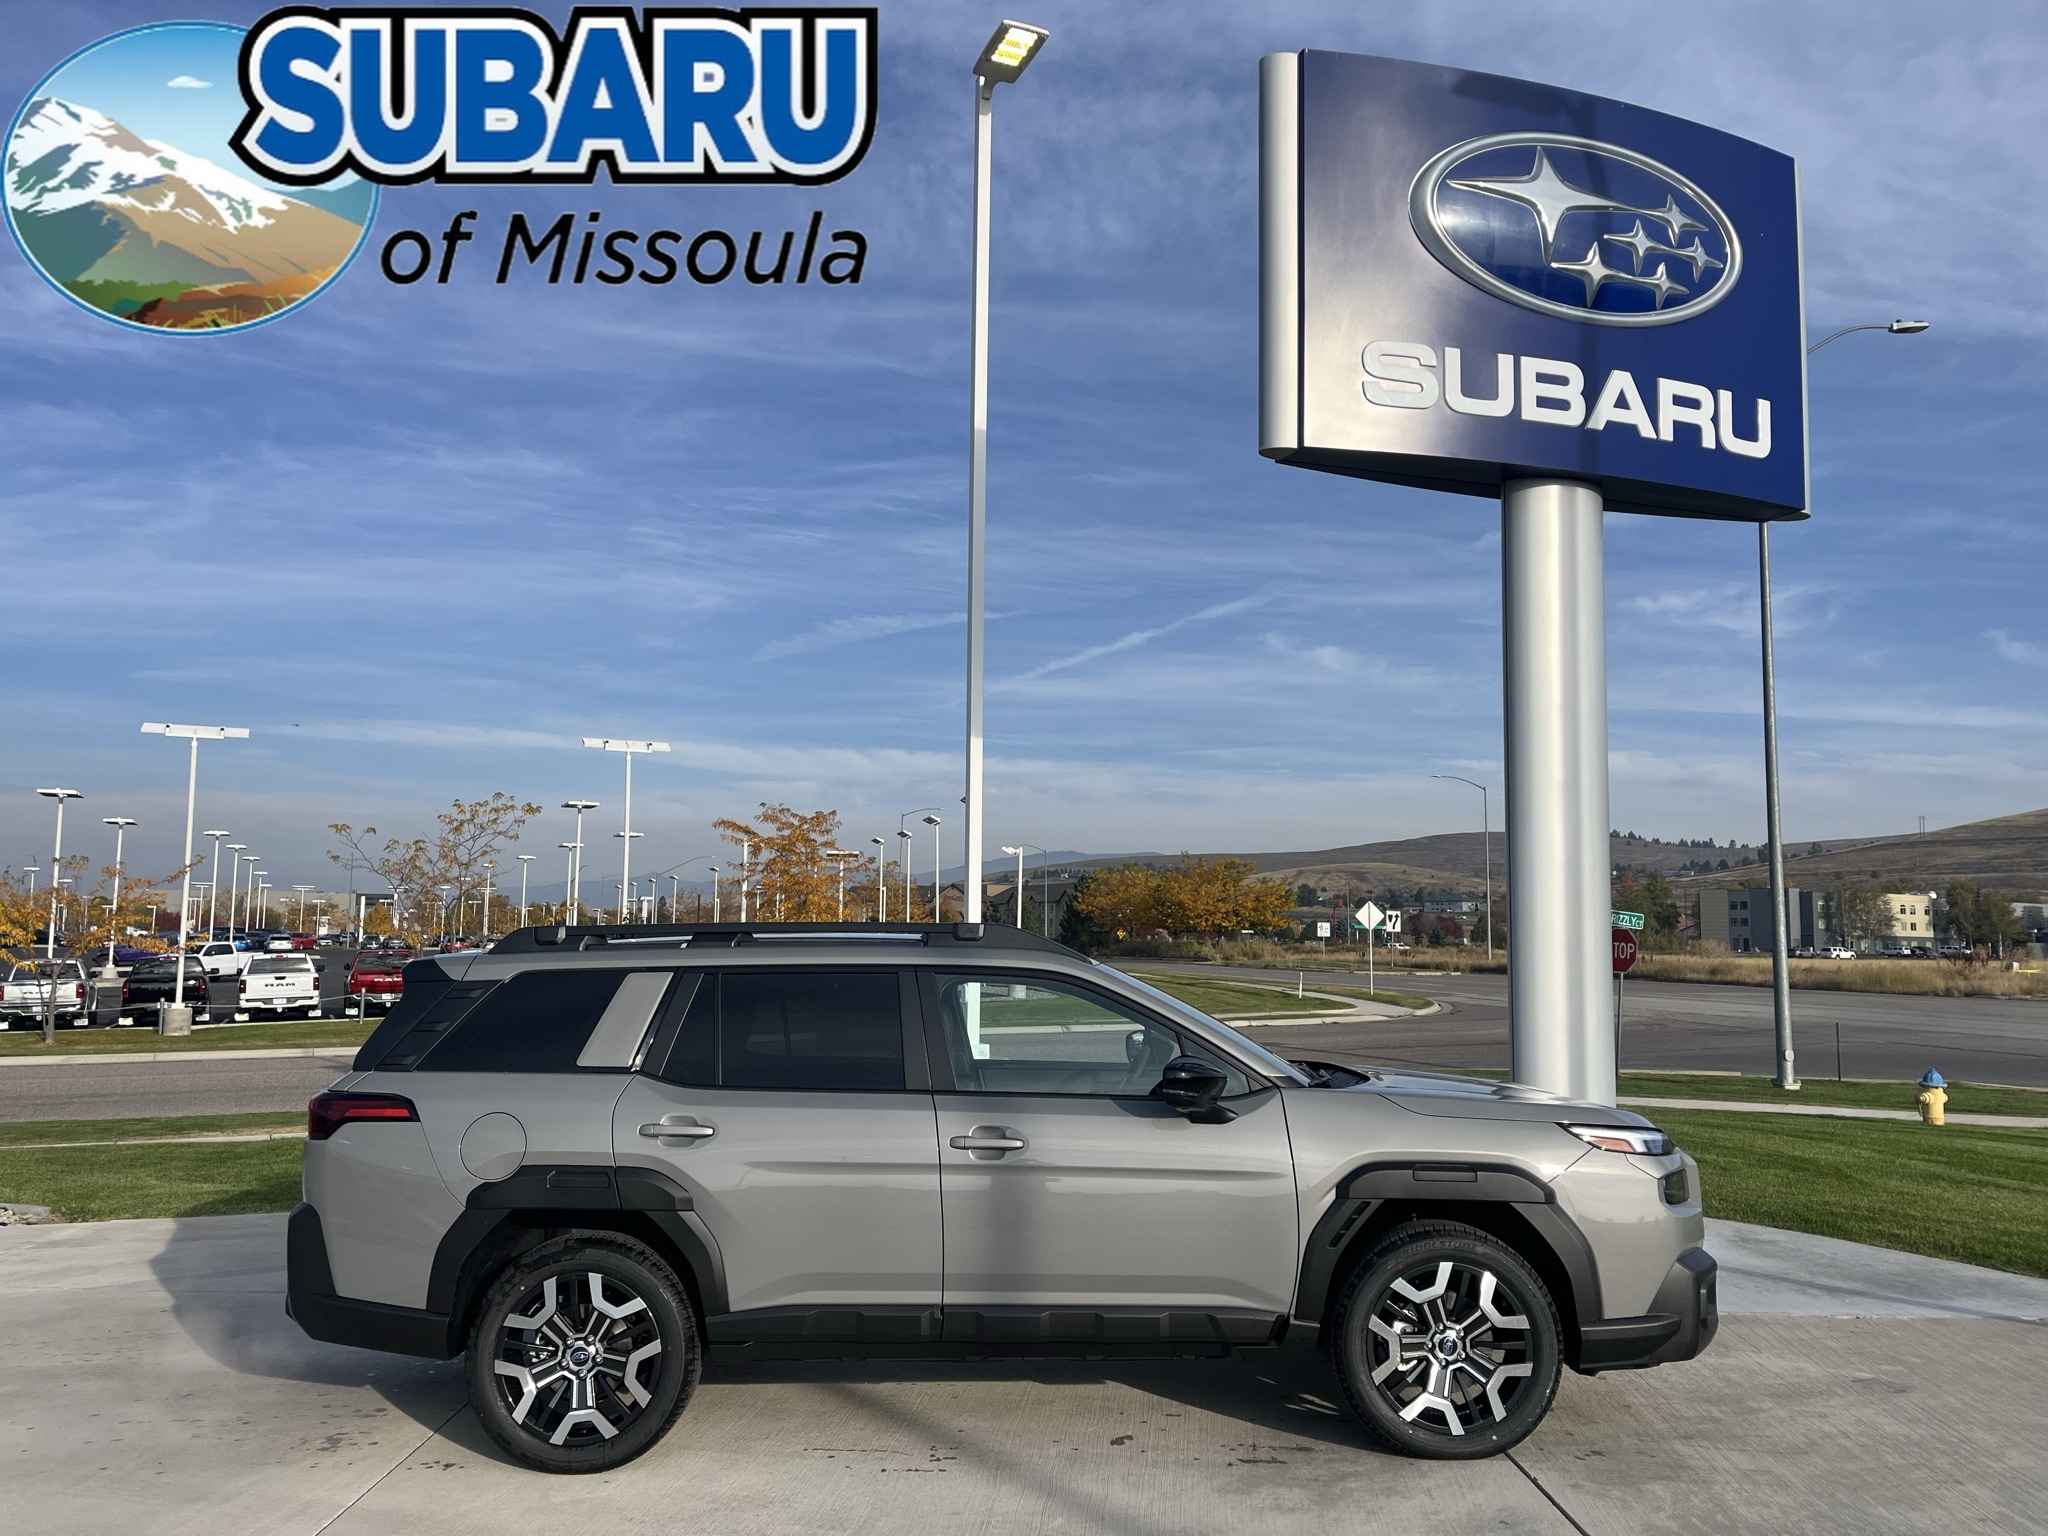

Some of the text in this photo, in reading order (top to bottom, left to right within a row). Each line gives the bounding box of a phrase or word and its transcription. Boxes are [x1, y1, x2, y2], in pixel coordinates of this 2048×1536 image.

[1361, 340, 1772, 459] SUBARU
[1611, 913, 1637, 927] RIZZLY
[1613, 942, 1635, 960] TOP
